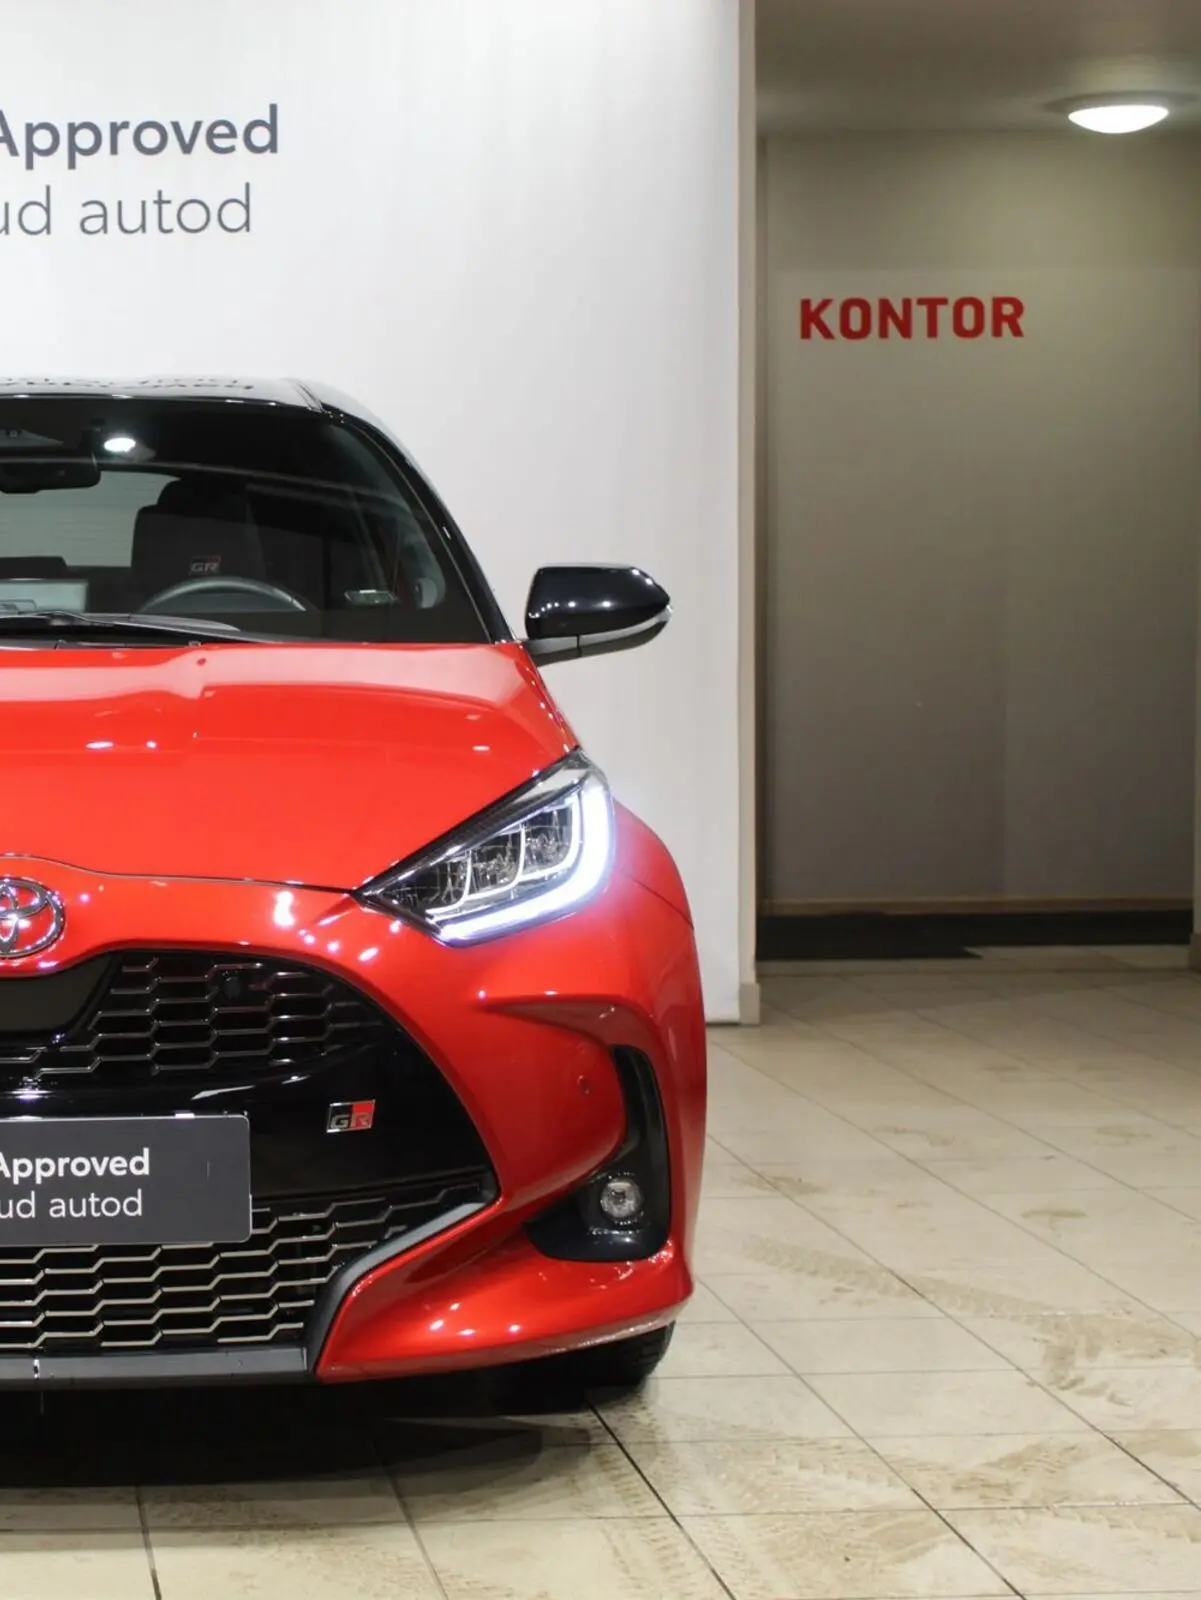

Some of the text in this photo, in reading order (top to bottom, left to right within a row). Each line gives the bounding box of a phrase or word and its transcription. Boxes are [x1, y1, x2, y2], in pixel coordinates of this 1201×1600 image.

[78, 181, 252, 236] autod
[800, 296, 1025, 340] KONTOR
[48, 1188, 143, 1218] autod
